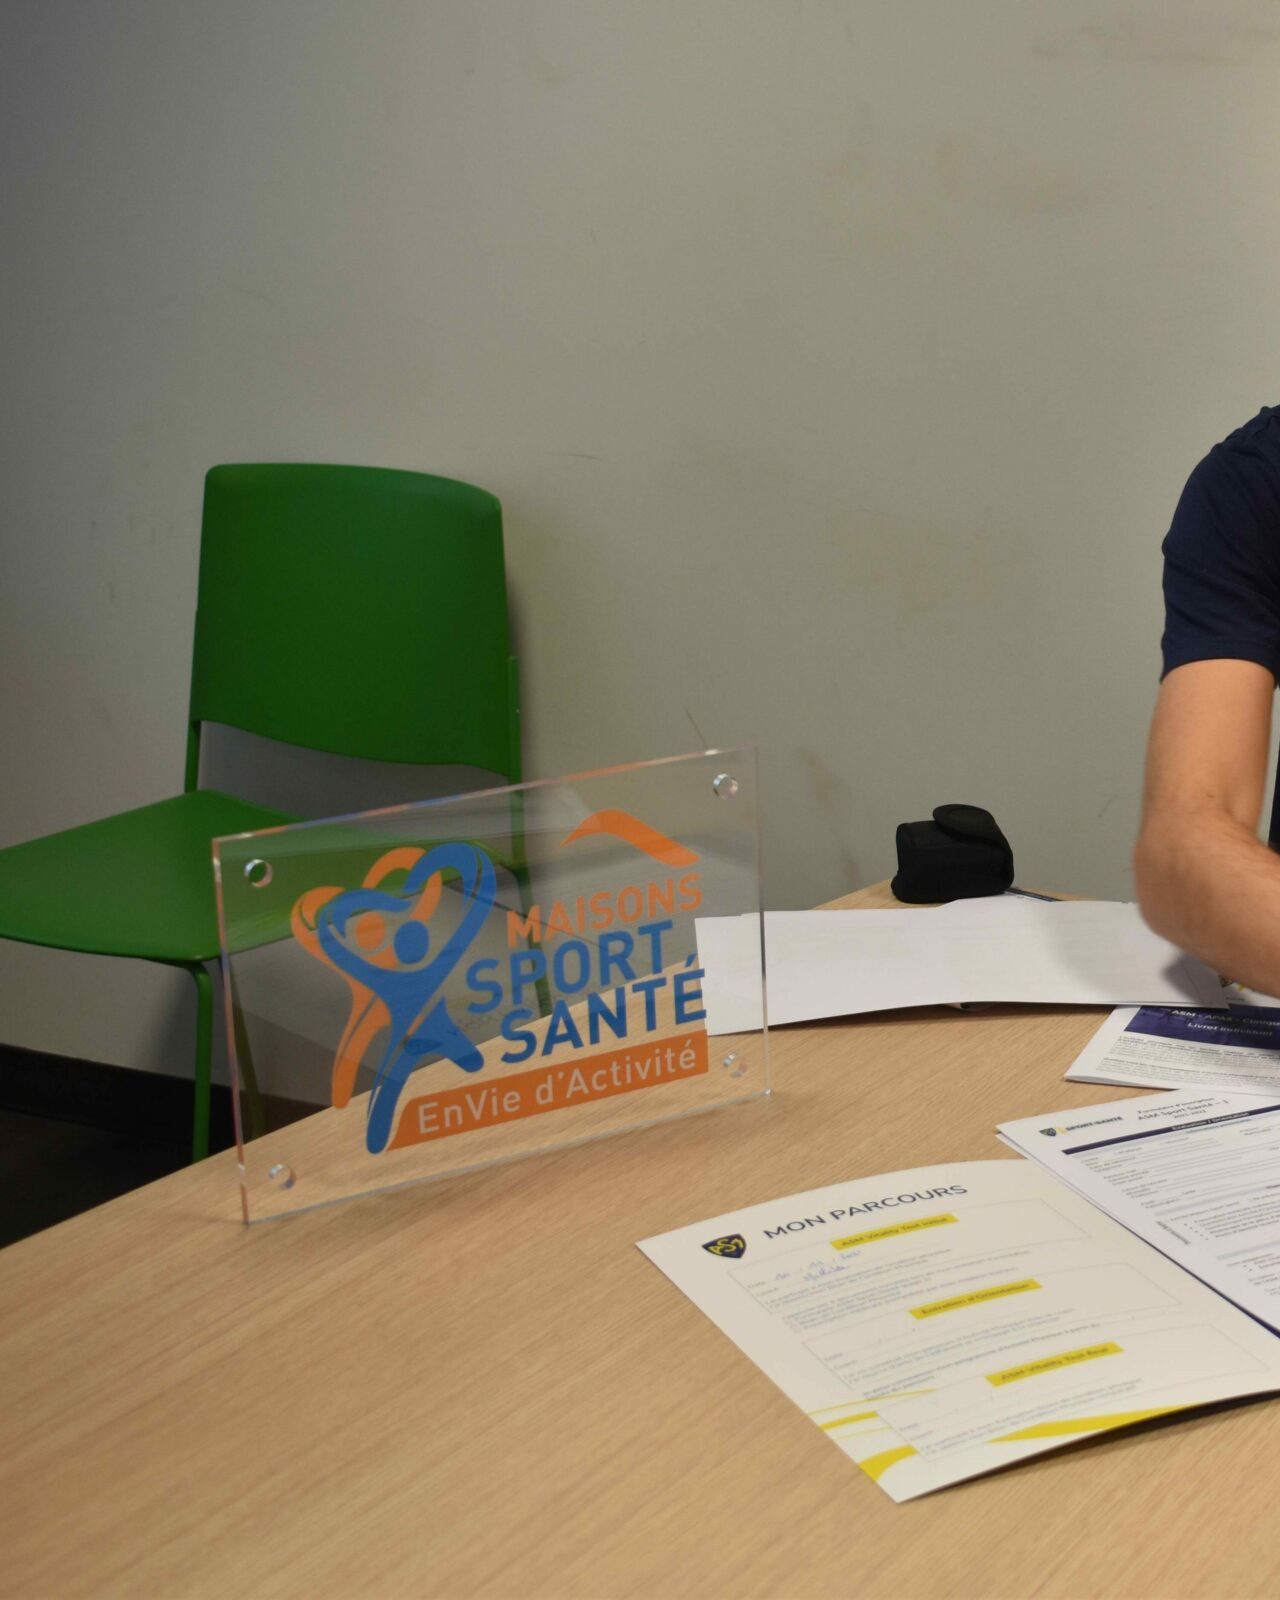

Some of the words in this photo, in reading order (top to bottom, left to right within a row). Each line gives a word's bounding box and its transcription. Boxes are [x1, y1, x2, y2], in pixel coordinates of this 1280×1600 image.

[506, 873, 702, 947] MAISONS
[466, 920, 673, 1014] SPORT
[500, 955, 708, 1063] SANTÉ
[1187, 1021, 1219, 1032] Livret
[418, 1091, 522, 1135] EnVie
[534, 1041, 697, 1106] d'Activité
[763, 1214, 826, 1240] MON
[829, 1184, 969, 1221] PARCOURS
